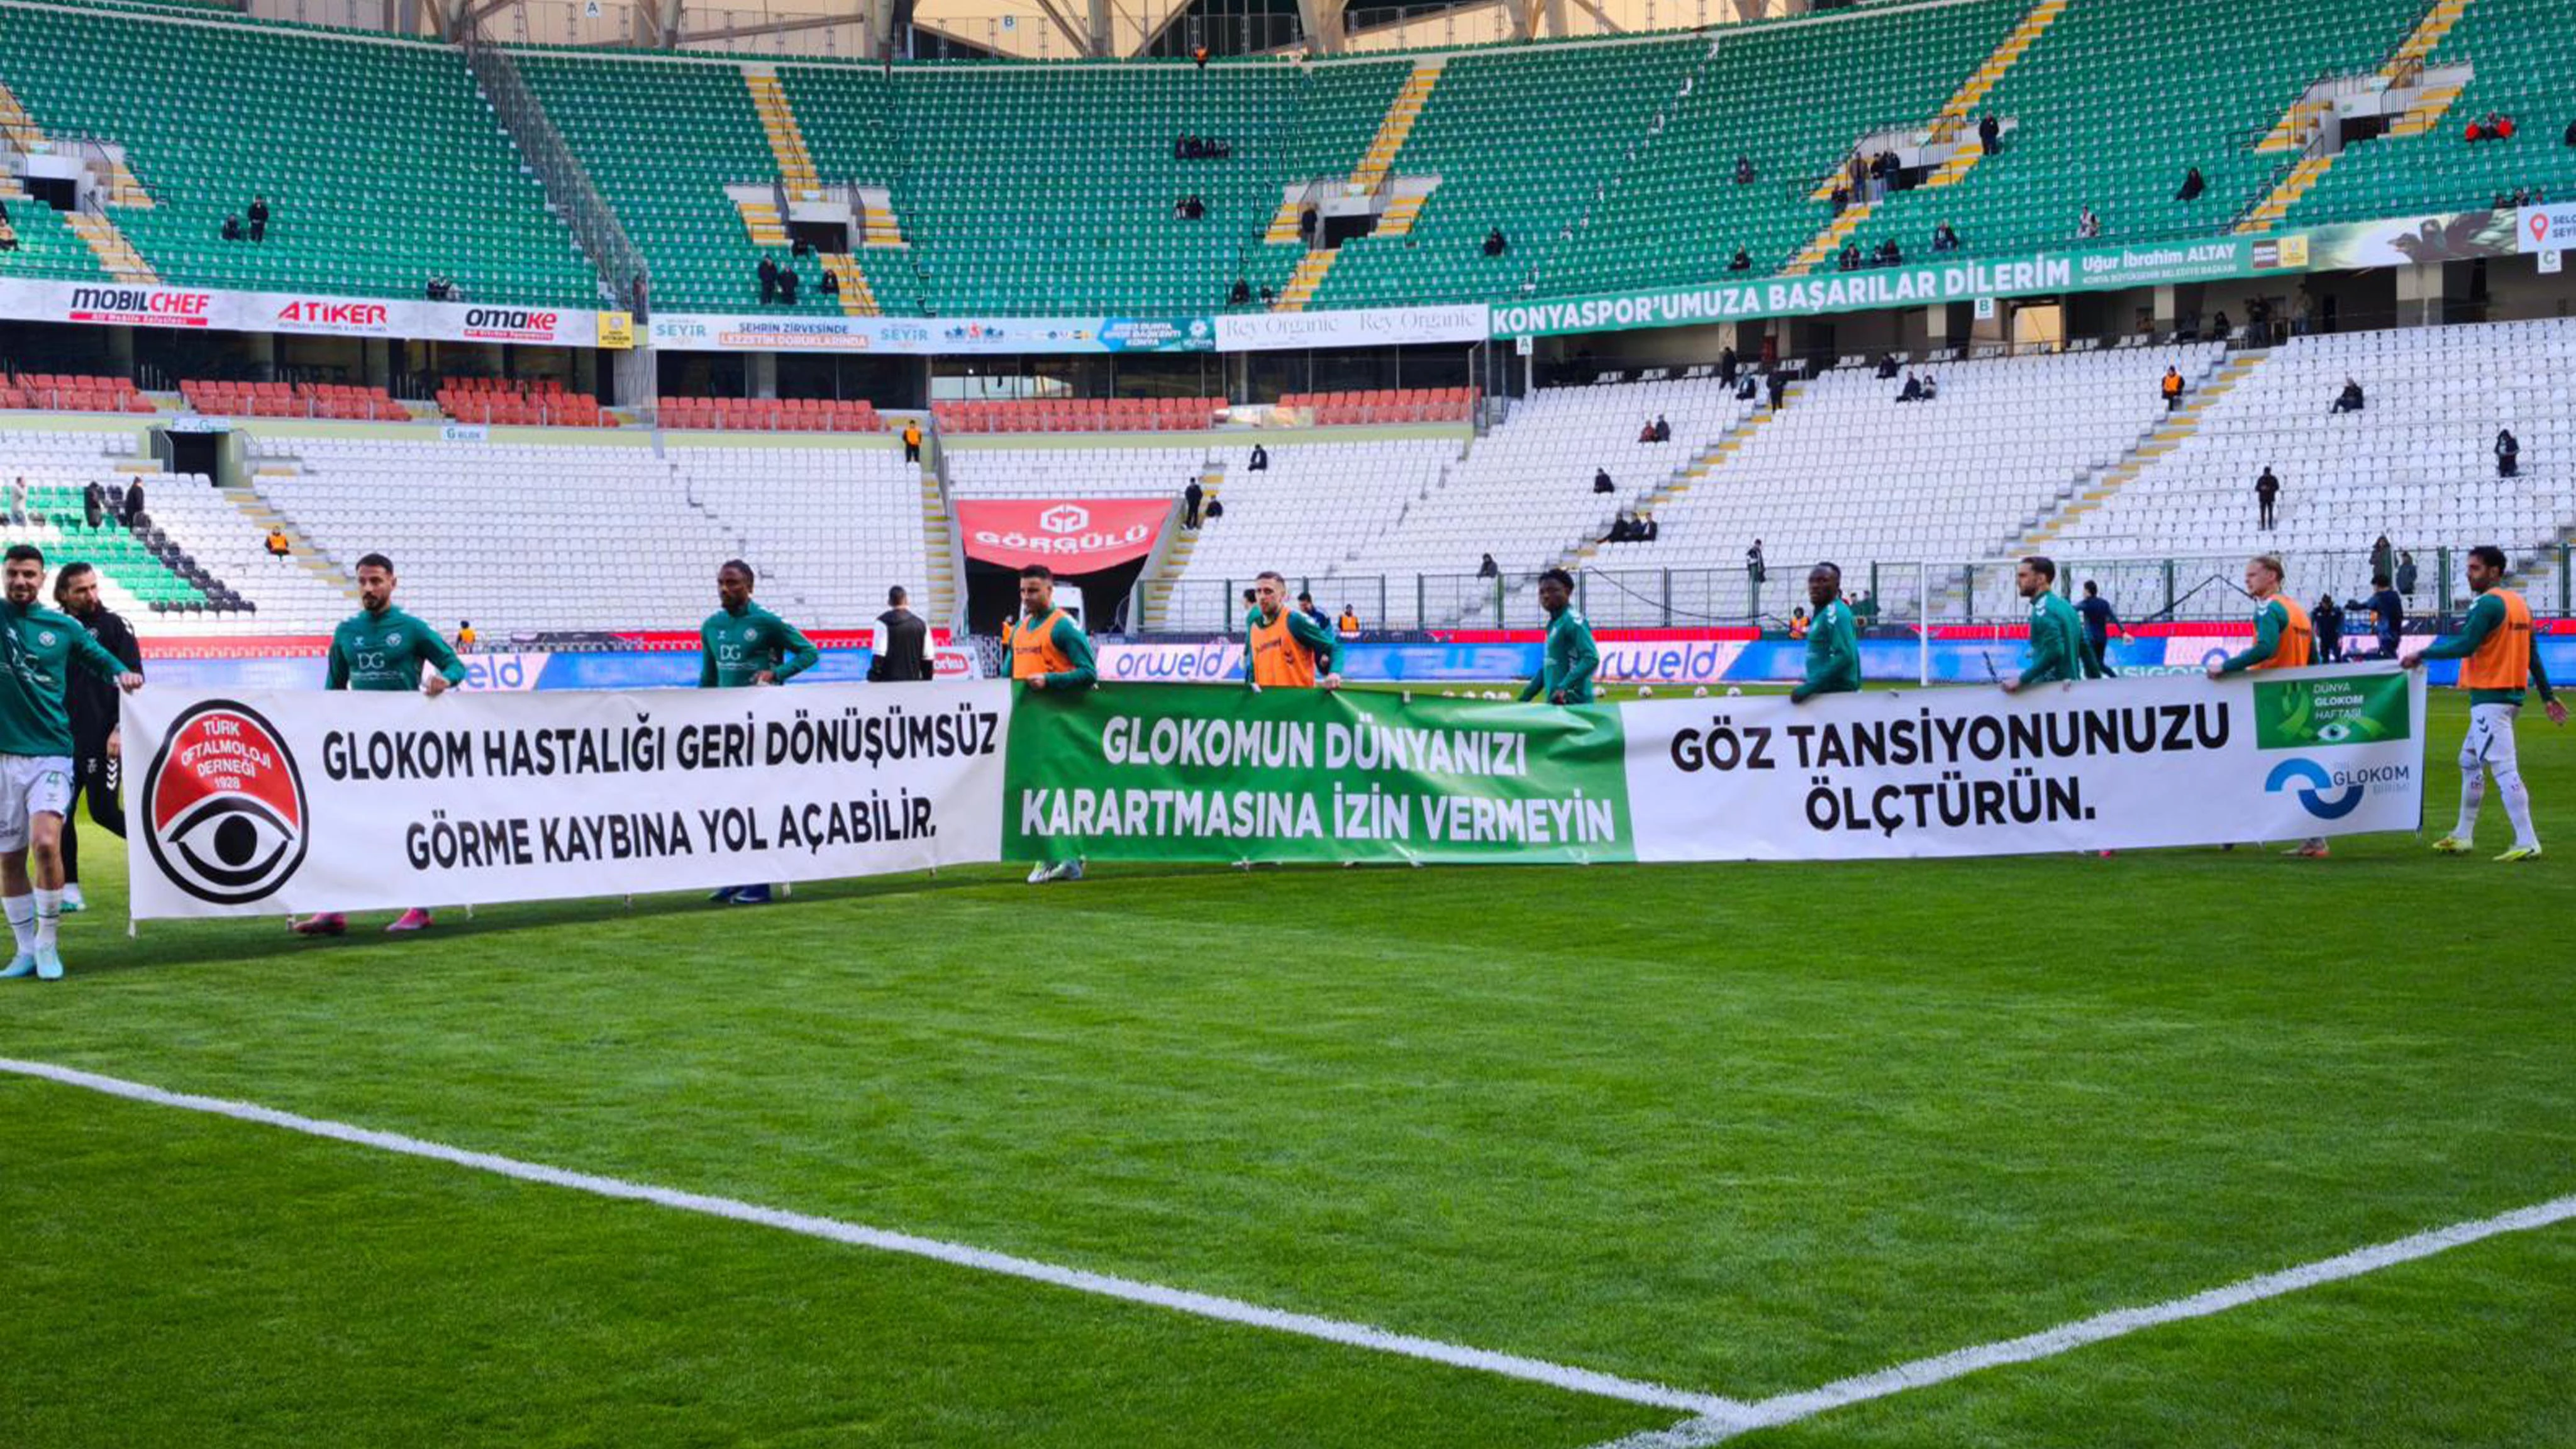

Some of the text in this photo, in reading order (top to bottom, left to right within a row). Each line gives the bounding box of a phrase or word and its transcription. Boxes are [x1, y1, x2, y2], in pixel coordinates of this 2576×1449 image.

[587, 2, 598, 13] A
[2083, 256, 2119, 273] Uğur
[2123, 250, 2182, 268] İbrahim
[2187, 243, 2237, 261] ALTAY
[2543, 251, 2555, 265] C
[1493, 253, 2070, 334] KONYASPOR'UMUZA BAŞARILAR DİLERİM
[1979, 299, 1989, 311] B
[783, 321, 849, 334] ZİRVESİNDE
[1226, 315, 1339, 340] Rey Organic
[1360, 309, 1477, 334] Rey Organic
[1520, 338, 1530, 348] A
[975, 524, 1149, 553] GÖRGÜLÜ
[1116, 646, 1224, 676] orweld
[1601, 643, 1718, 679] rweld
[2313, 681, 2351, 694] DÜNYA
[2314, 695, 2364, 707] GLOKOM
[203, 716, 240, 736] TÜRK
[1670, 702, 2229, 772] GÖZ TANSİYONUNUZU
[323, 702, 998, 780] GLOKOM HASTALIĞI GERİ DÖNÜŞÜMSÜZ
[1102, 712, 1526, 776] GLOKOMUN DÜNYANIZI
[2333, 764, 2409, 787] GLOKOM
[1021, 781, 1616, 843] KARARTMASINA İZİN VERMEYİN
[1805, 767, 2096, 838] ÖLÇTÜRÜN.
[406, 787, 937, 870] GÖRME KAYBINA YOL AÇABİLİR.
